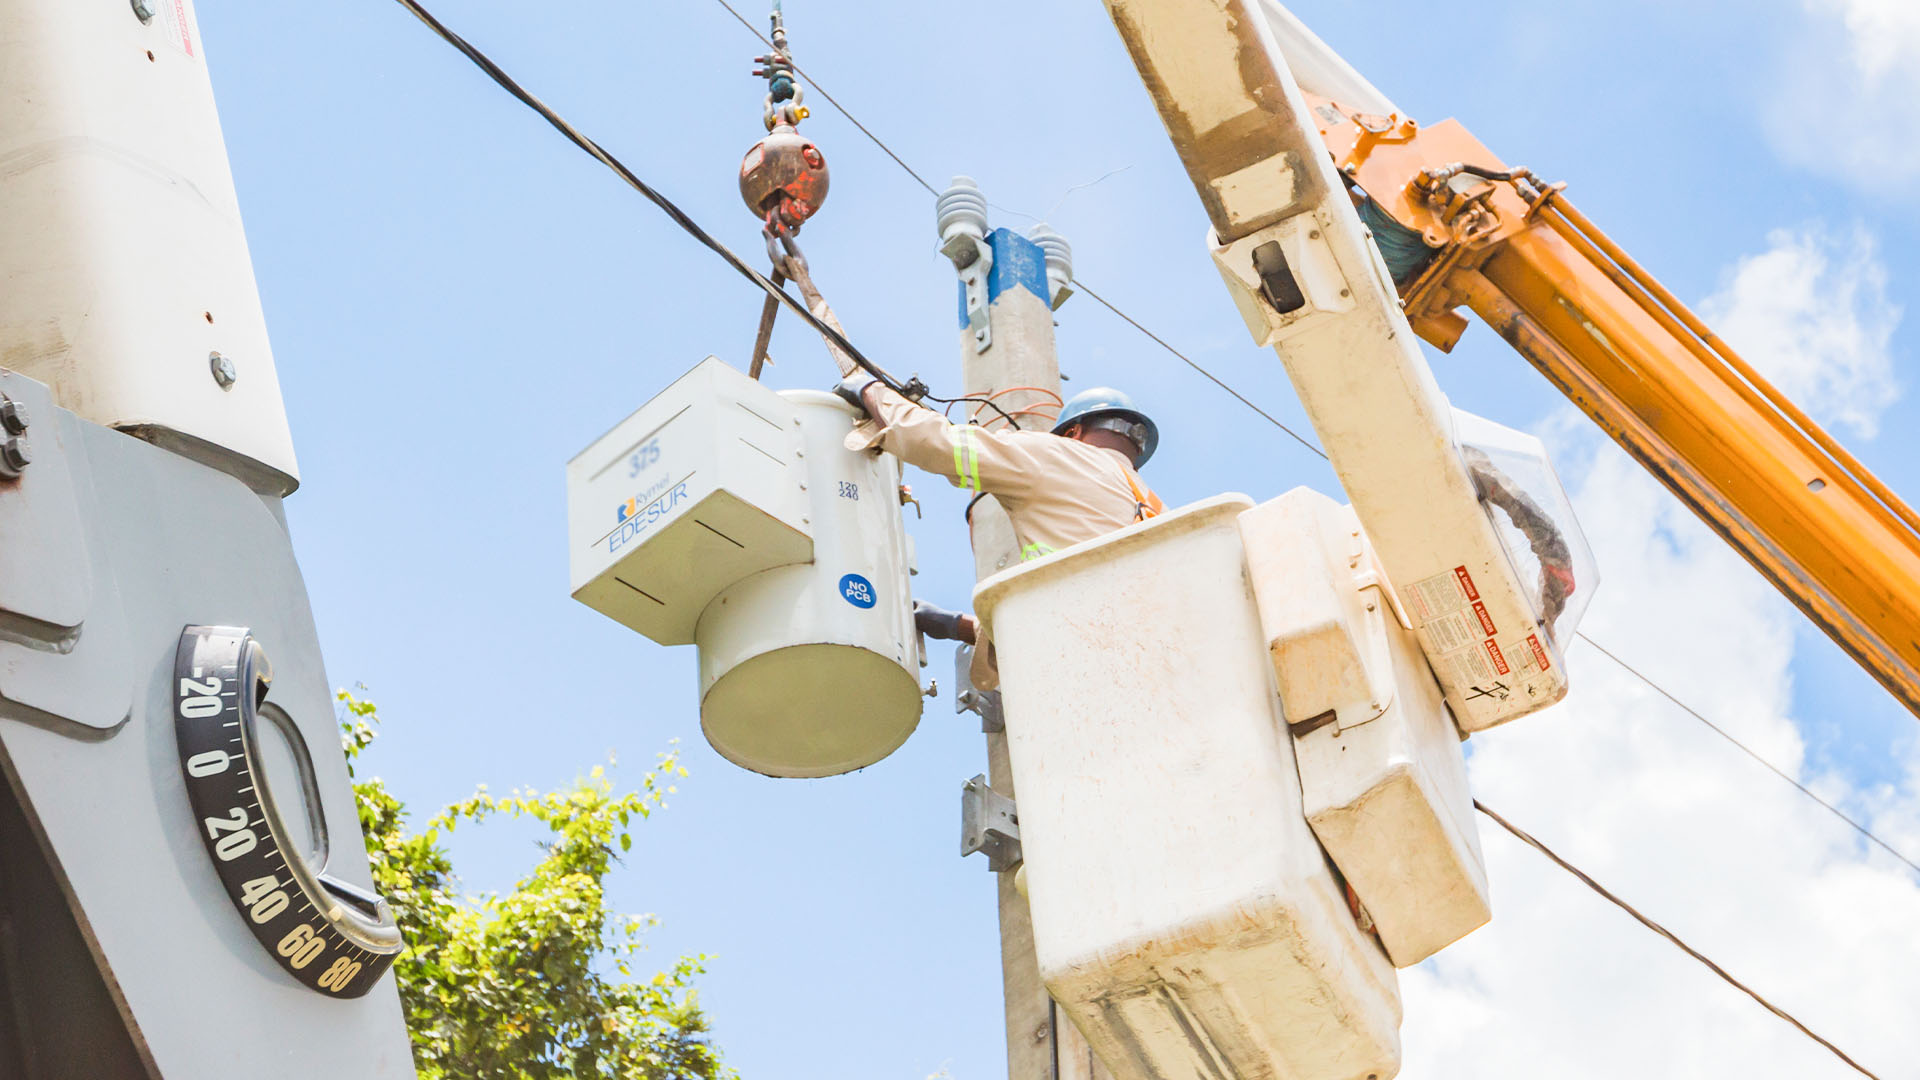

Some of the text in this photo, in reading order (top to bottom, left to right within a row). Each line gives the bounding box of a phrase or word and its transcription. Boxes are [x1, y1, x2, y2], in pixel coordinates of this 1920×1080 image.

[838, 481, 858, 492] 120
[839, 489, 859, 501] 240
[609, 483, 688, 553] EDESUR
[846, 589, 871, 603] PCB
[848, 581, 867, 593] NO
[1462, 575, 1476, 598] DANGER
[1479, 608, 1494, 634] DANGER
[1490, 645, 1507, 674] DANGER
[1532, 642, 1548, 670] DANGER
[180, 667, 222, 719] -20
[187, 750, 230, 778] 0
[204, 806, 257, 862] 20
[240, 874, 289, 924] 40
[277, 923, 326, 970] 60
[317, 956, 362, 993] 80
